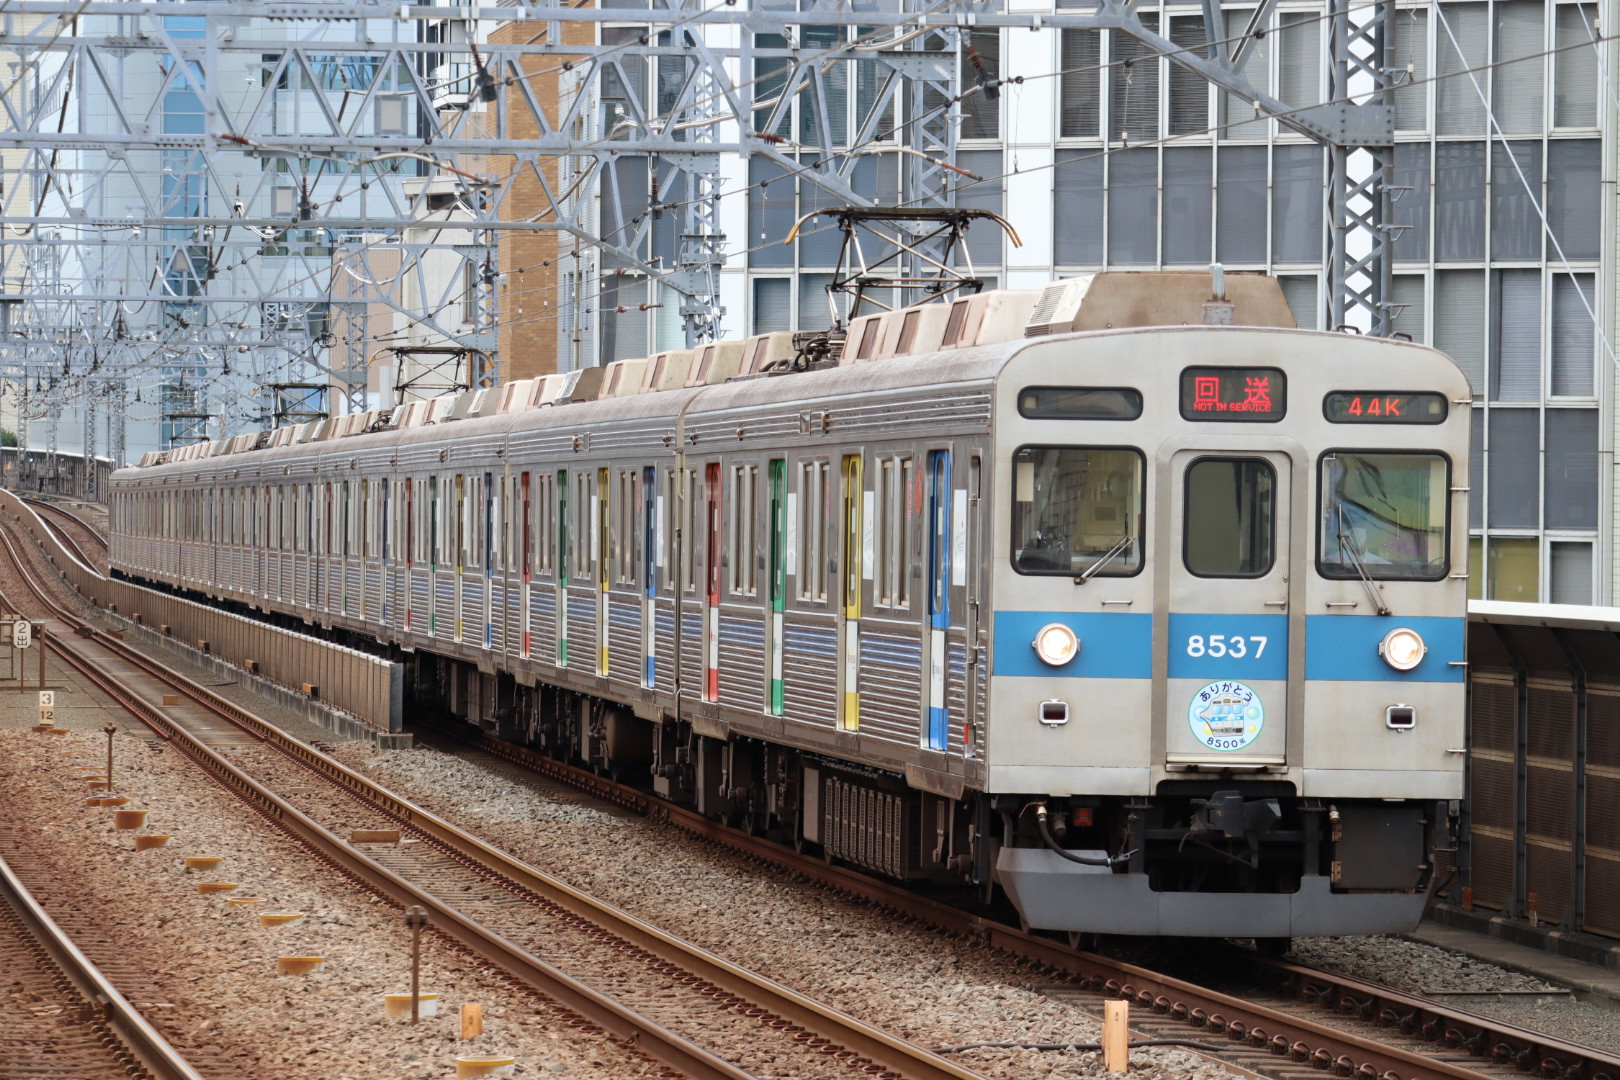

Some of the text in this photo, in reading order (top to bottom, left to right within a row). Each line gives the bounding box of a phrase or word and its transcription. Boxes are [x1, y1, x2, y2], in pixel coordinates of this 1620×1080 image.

[1194, 402, 1272, 412] NOT IN SERVICE
[1348, 397, 1400, 416] 44K
[18, 622, 26, 633] 2
[1187, 635, 1267, 658] 8537
[1200, 682, 1253, 702] ありがとう
[42, 693, 51, 704] 3
[41, 711, 53, 720] 12
